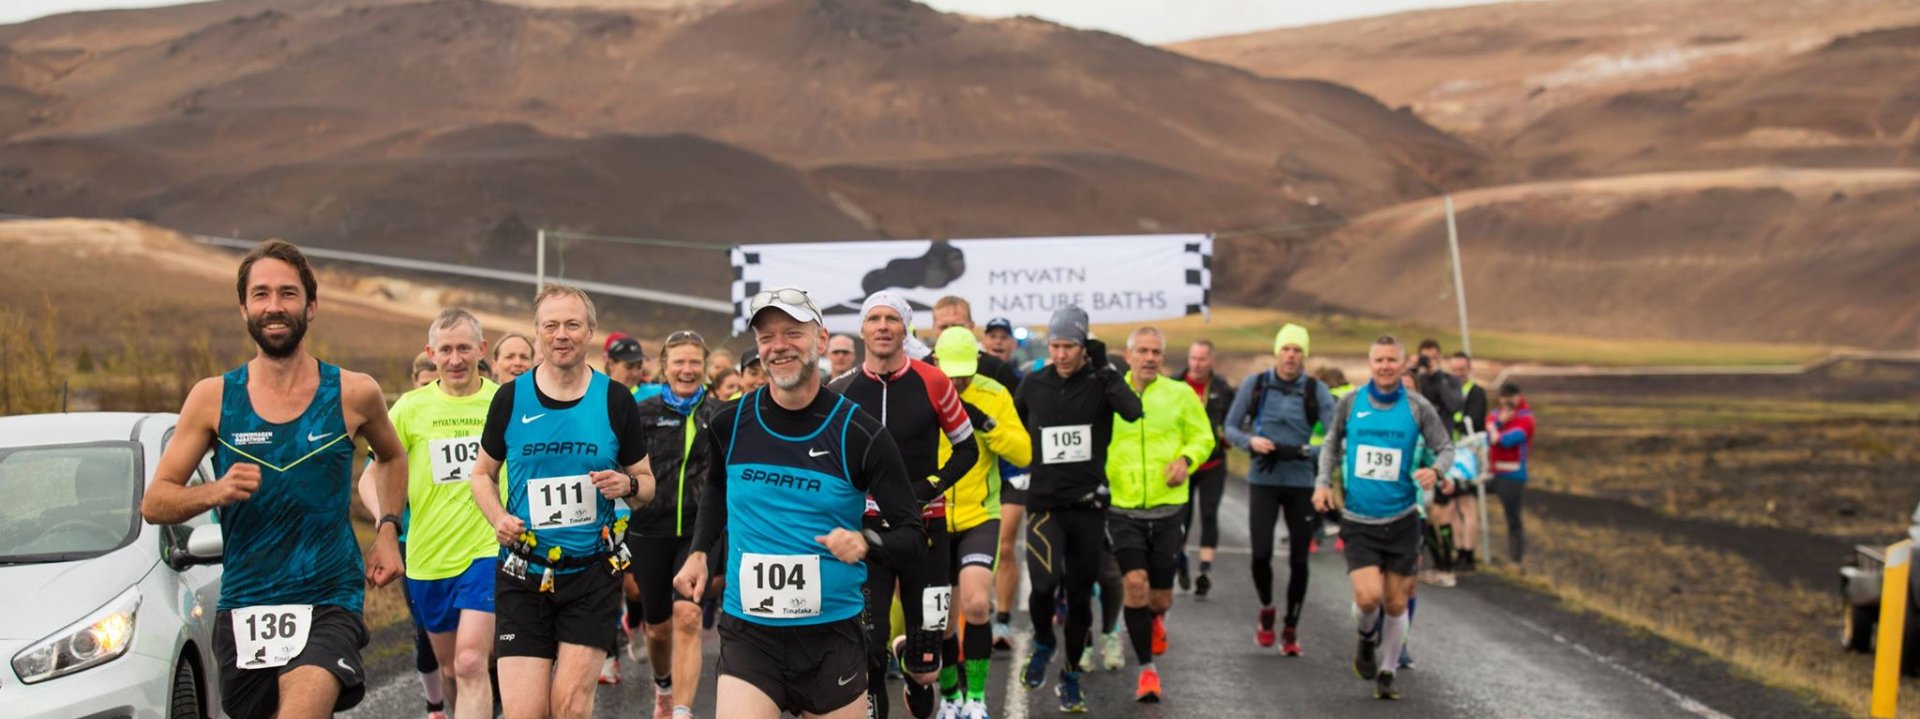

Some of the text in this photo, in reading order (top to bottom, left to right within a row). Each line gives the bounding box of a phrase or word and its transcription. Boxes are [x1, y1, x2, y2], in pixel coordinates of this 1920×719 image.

[989, 267, 1086, 285] MYVATN
[990, 290, 1167, 312] NATURE BATHS
[522, 442, 598, 456] SPARTA
[1053, 431, 1082, 447] 105
[441, 442, 480, 463] 103
[1366, 451, 1393, 467] 139
[741, 468, 822, 492] SPARTA
[540, 482, 583, 506] 111
[753, 562, 806, 591] 104
[246, 613, 297, 641] 136
